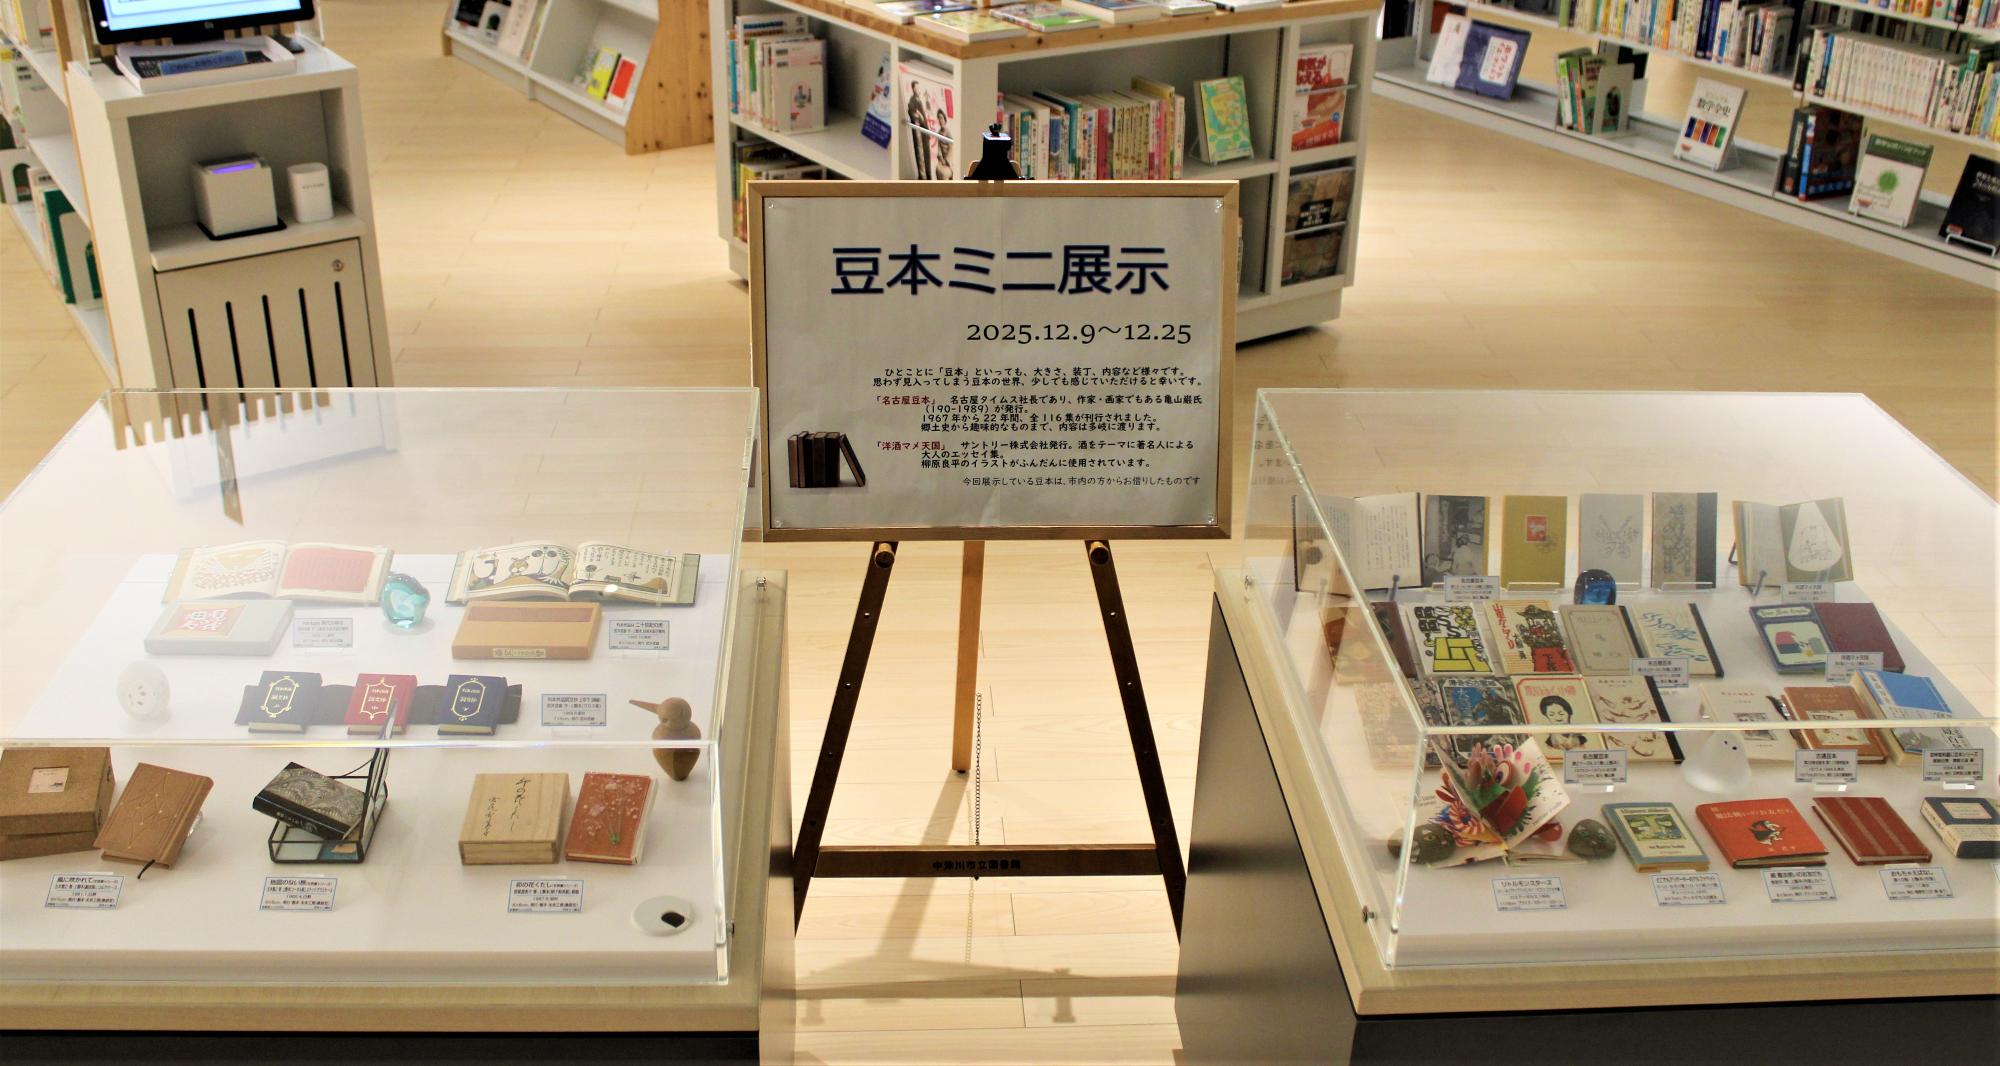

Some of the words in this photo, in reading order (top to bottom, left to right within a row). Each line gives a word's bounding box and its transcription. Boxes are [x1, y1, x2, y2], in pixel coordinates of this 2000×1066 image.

[831, 243, 1170, 296] 豆本ミニ展示
[885, 367, 1185, 377] ひとことに「豆本」といっても、大きさ、装丁、内容など様々です。
[873, 376, 1202, 387] 思わず見入ってしまう豆本の世界、少しでも感じていただけると幸いです。
[876, 395, 936, 405] 「名古屋豆本」
[921, 422, 1162, 432] 郷土史から趣味的なものまで、内容は多岐に渡ります。
[877, 441, 946, 451] 「洋酒マメ天国」
[960, 440, 1194, 450] サントリー株式会社発行。酒をテーマに著名人による
[921, 450, 1004, 459] 大人のエッセイ集。
[921, 459, 1151, 469] 柳原良平のイラストがふんだんに使用されています。
